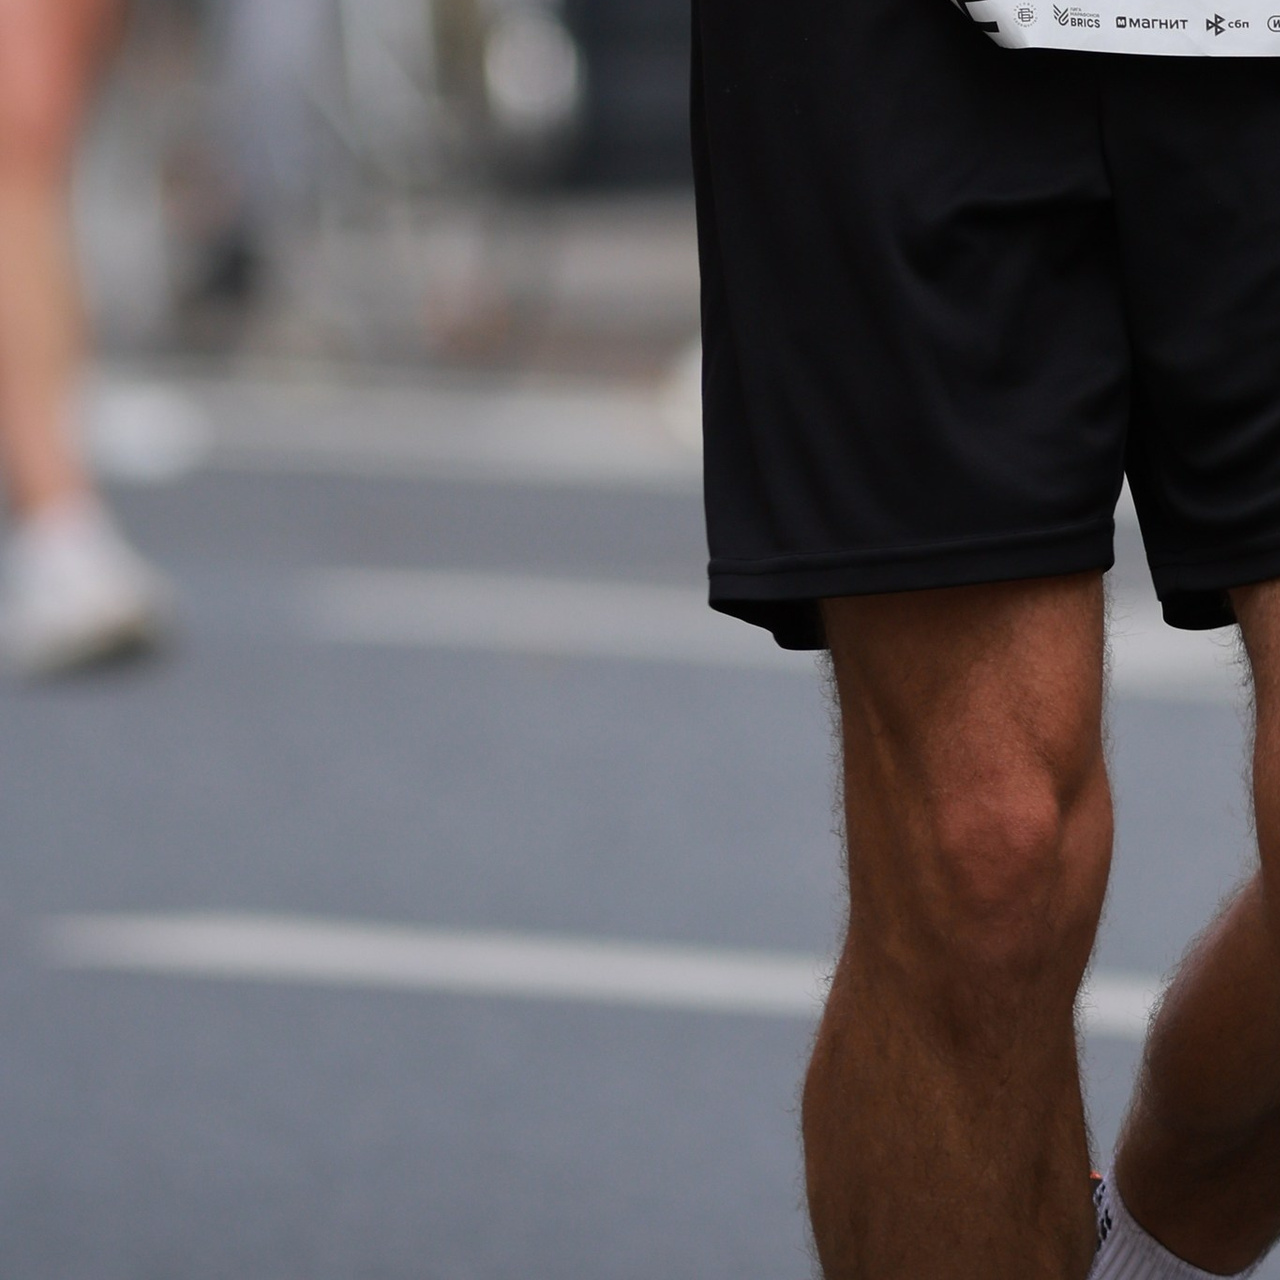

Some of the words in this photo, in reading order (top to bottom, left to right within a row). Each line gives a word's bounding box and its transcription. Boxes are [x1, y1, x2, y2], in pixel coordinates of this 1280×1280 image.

[1070, 17, 1101, 29] BRICS
[1128, 17, 1189, 30] магнит
[1228, 19, 1250, 29] сбп
